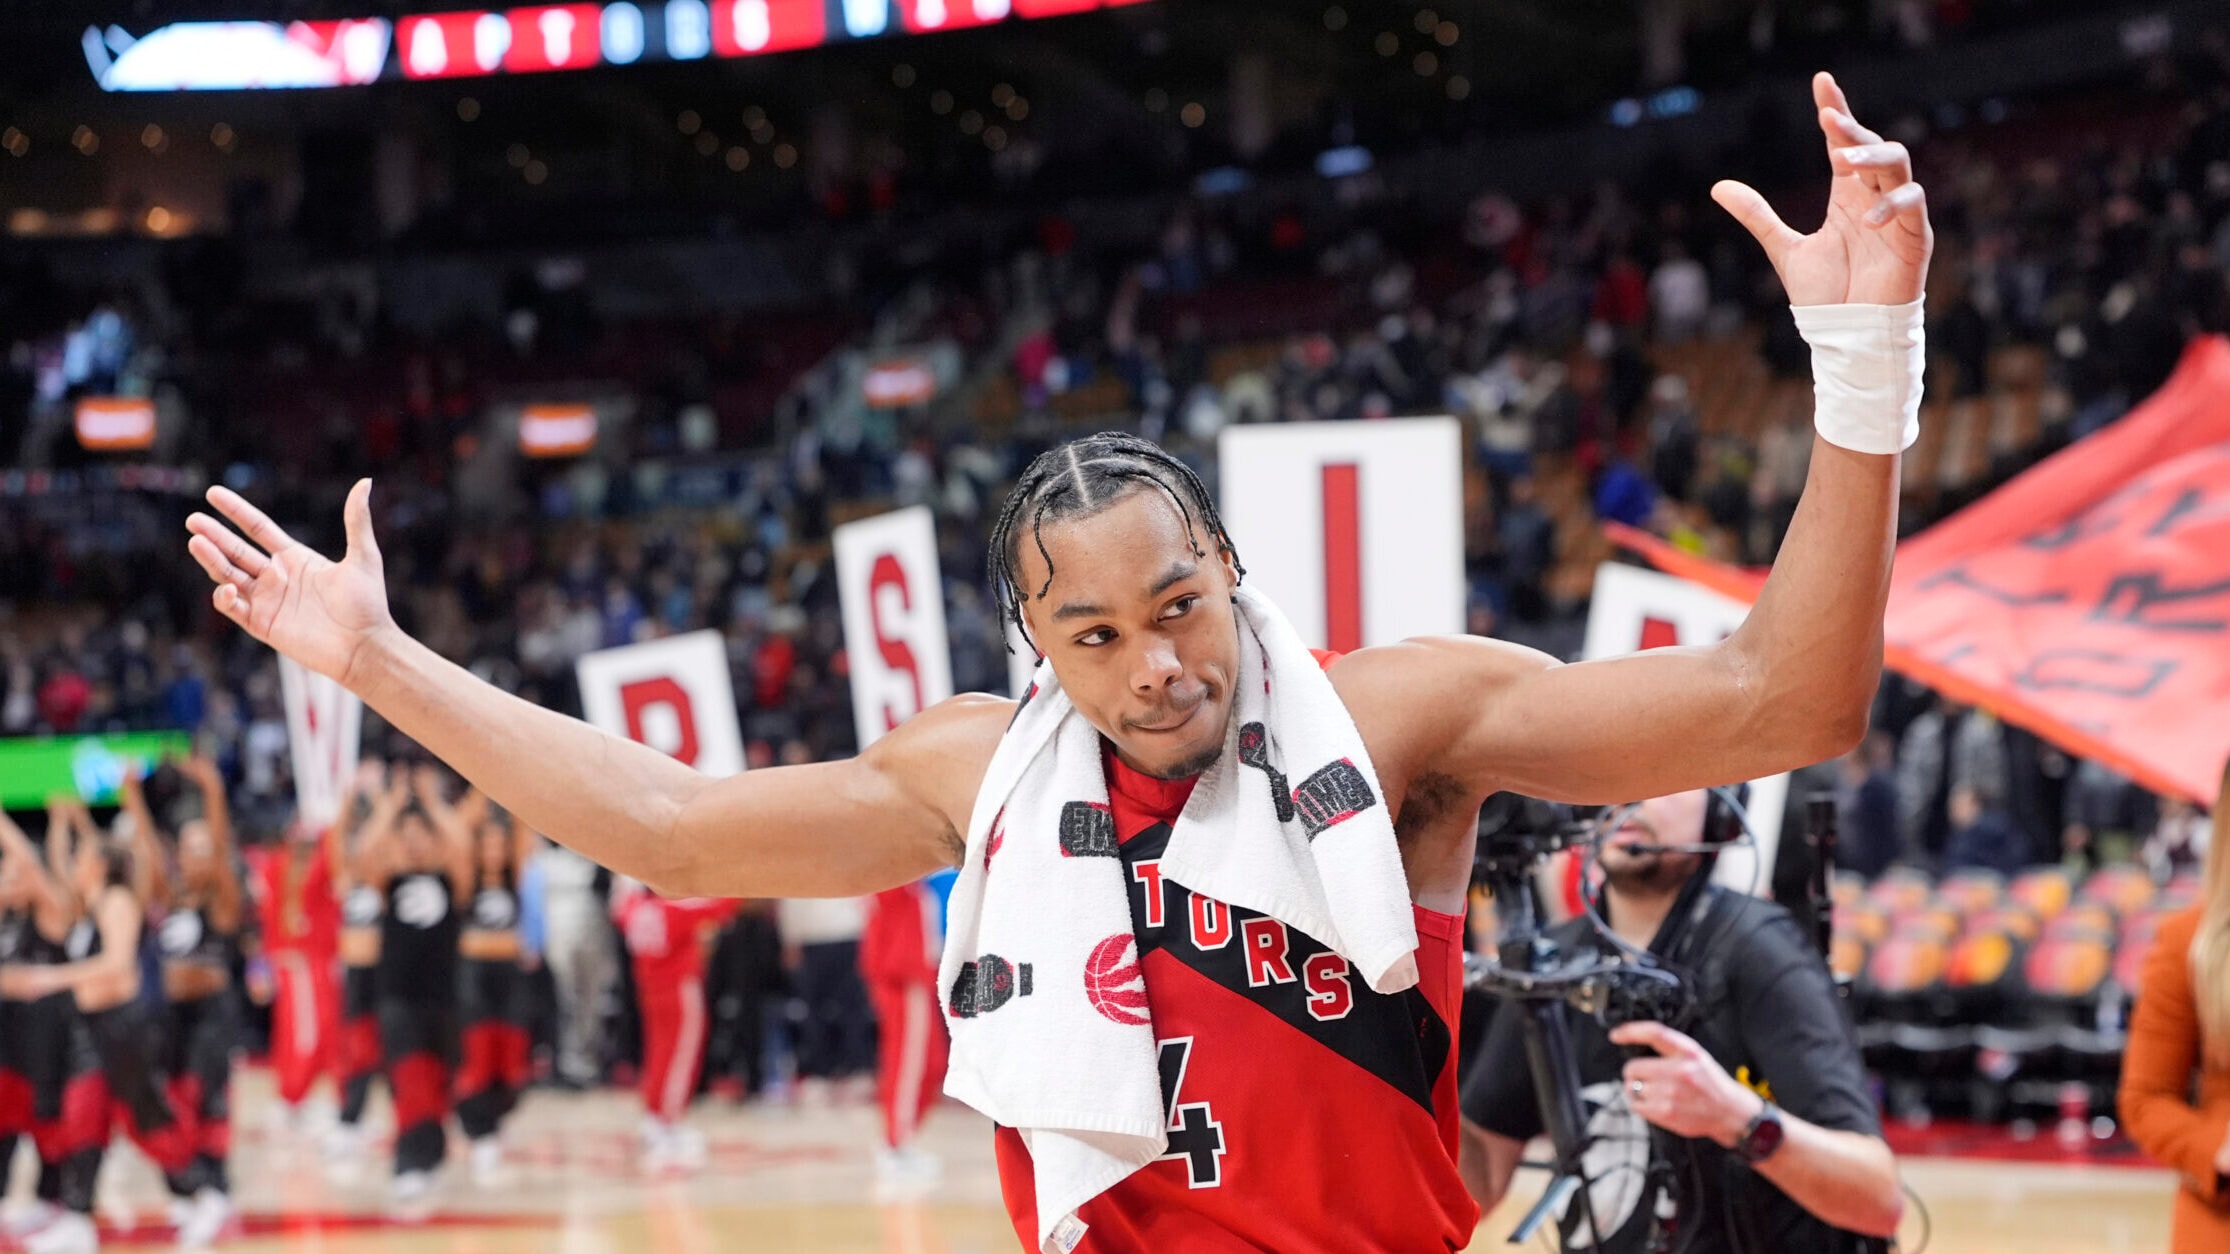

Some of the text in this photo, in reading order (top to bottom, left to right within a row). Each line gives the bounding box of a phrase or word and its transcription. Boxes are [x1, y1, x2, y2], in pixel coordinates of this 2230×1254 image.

[869, 553, 923, 731] S
[1132, 858, 1354, 1022] TORS
[1153, 1035, 1227, 1190] 4
